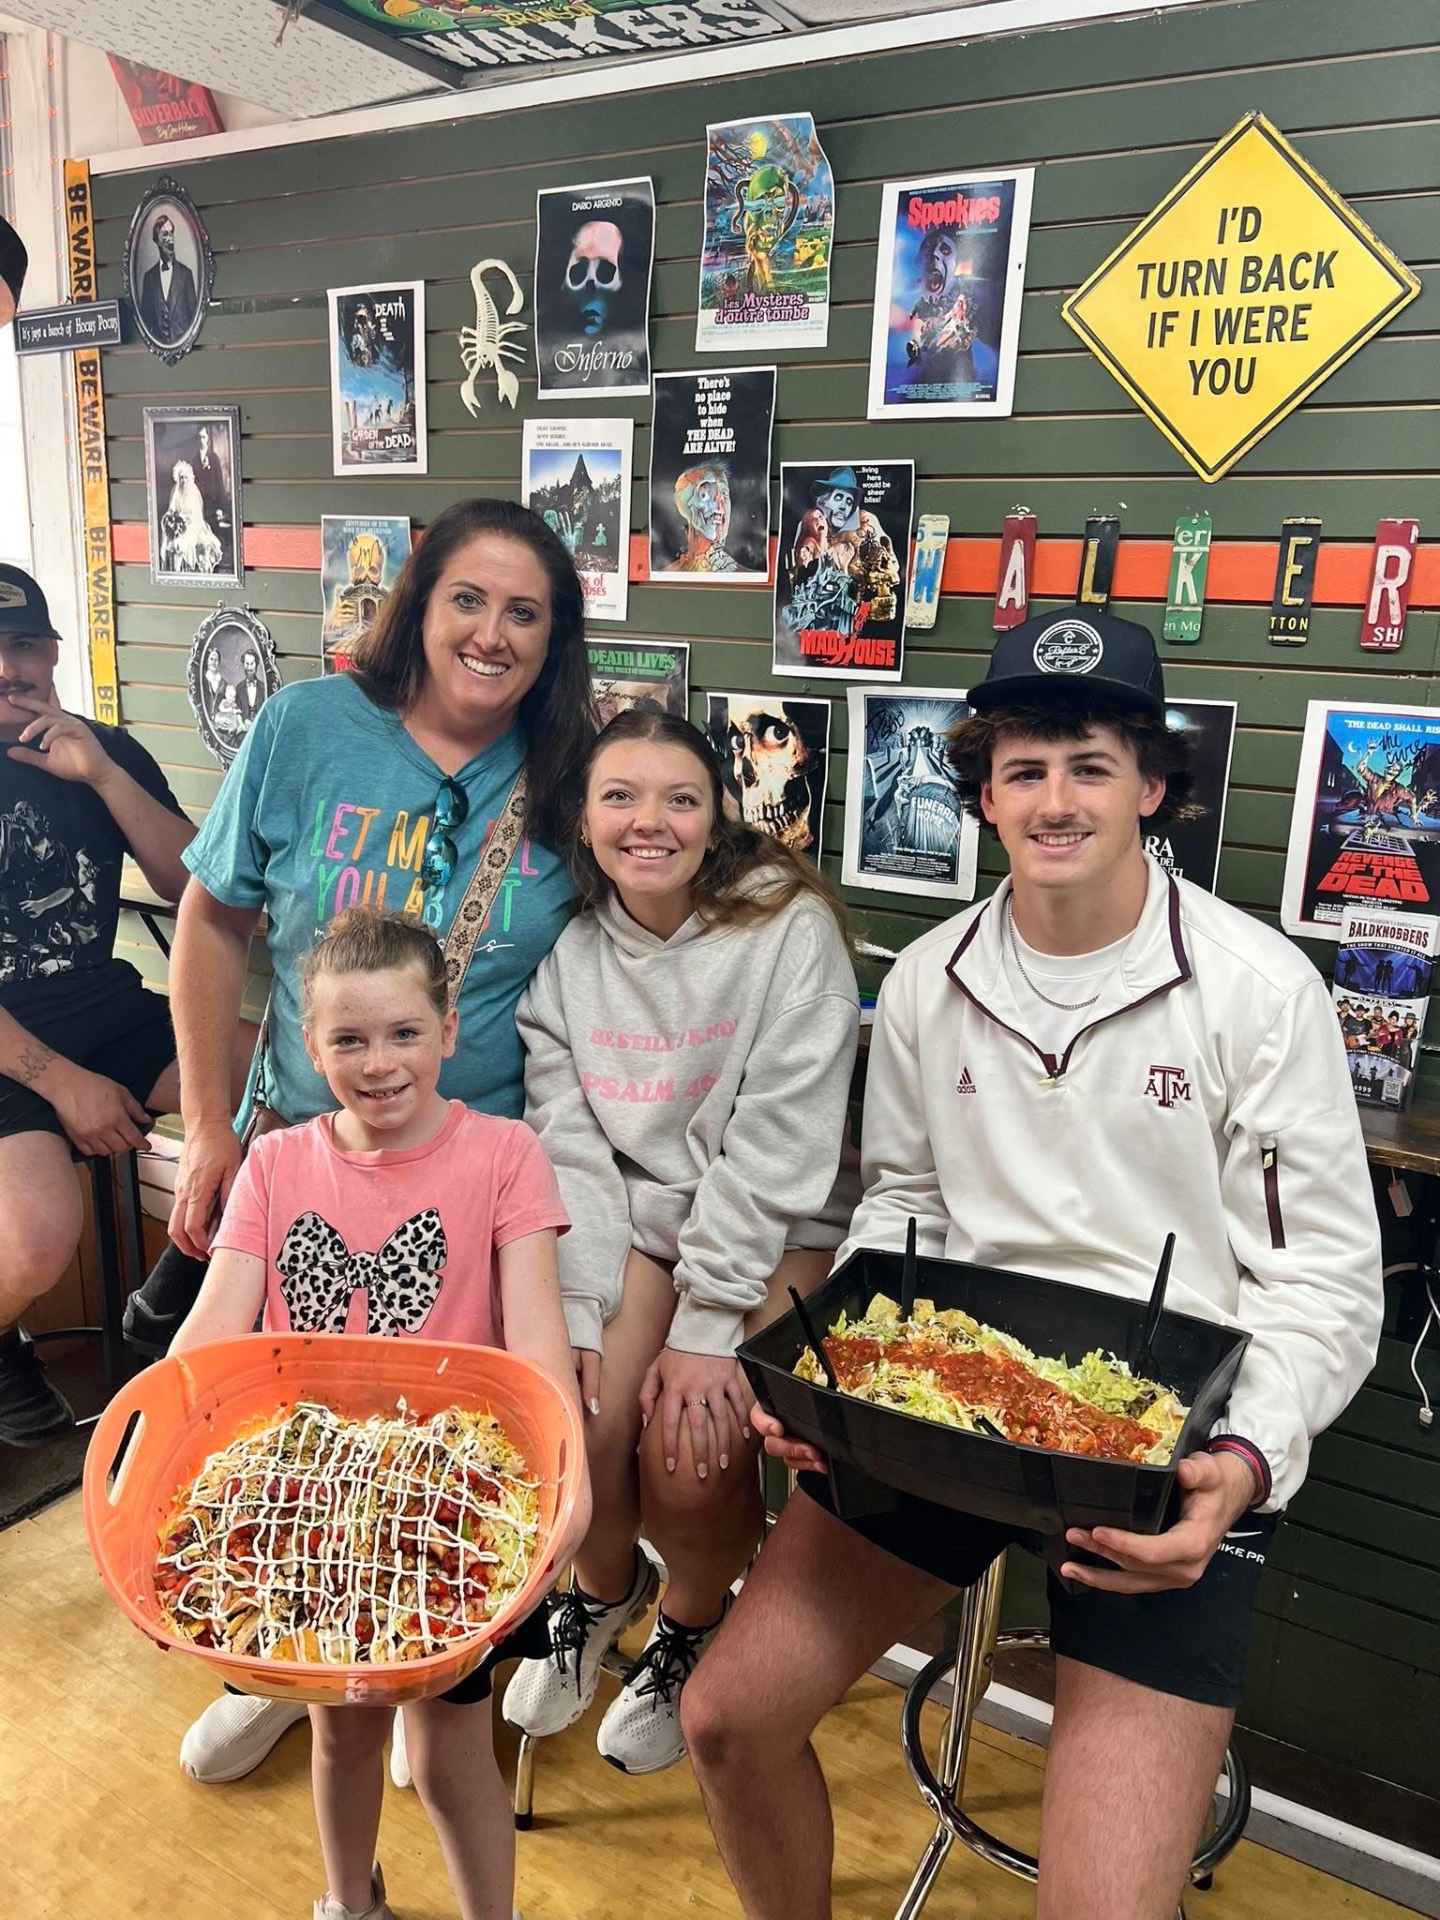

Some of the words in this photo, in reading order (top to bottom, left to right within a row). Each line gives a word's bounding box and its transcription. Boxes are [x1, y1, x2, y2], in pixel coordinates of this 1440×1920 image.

[133, 98, 211, 127] SILVERBACK
[572, 201, 592, 211] DARIO
[593, 198, 623, 208] ARGENTO
[908, 193, 1001, 232] Spookies
[1217, 206, 1262, 245] I'D
[67, 183, 94, 303] BEWAR
[1137, 257, 1228, 299] TURN
[1240, 250, 1339, 294] BACK
[742, 293, 804, 310] Mystères
[766, 306, 809, 321] tombe
[75, 317, 97, 337] Hocus
[97, 315, 119, 333] Pocus
[1147, 311, 1179, 348] IF
[1190, 309, 1200, 346] I
[1214, 303, 1312, 345] WERE
[554, 341, 633, 382] Inferno
[697, 376, 731, 390] There's
[1188, 357, 1257, 395] YOU
[695, 393, 706, 403] no
[707, 390, 732, 404] place
[697, 405, 706, 415] to
[708, 402, 728, 415] hide
[79, 359, 104, 483] BEWARE
[700, 416, 724, 428] when
[384, 433, 411, 449] DEAD
[687, 429, 707, 441] THE
[708, 428, 734, 441] DEAD
[683, 442, 703, 454] ARE
[703, 441, 737, 454] ALIVE!
[89, 526, 112, 646] BEWARE
[798, 629, 896, 667] MADHOUSE
[587, 649, 634, 666] DEATH
[637, 652, 676, 670] LIVES
[1367, 721, 1391, 731] DEAD
[1393, 723, 1423, 732] SHALL
[911, 796, 956, 823] FUNERAL
[917, 808, 945, 829] HOME
[310, 800, 381, 861] LET
[1338, 851, 1419, 869] REVENGE
[1330, 862, 1367, 875] OF
[1369, 865, 1423, 882] THE
[1316, 872, 1430, 903] DEAD
[582, 1071, 676, 1103] PSALM
[957, 1085, 977, 1094] adidas
[1217, 1542, 1246, 1558] IKE
